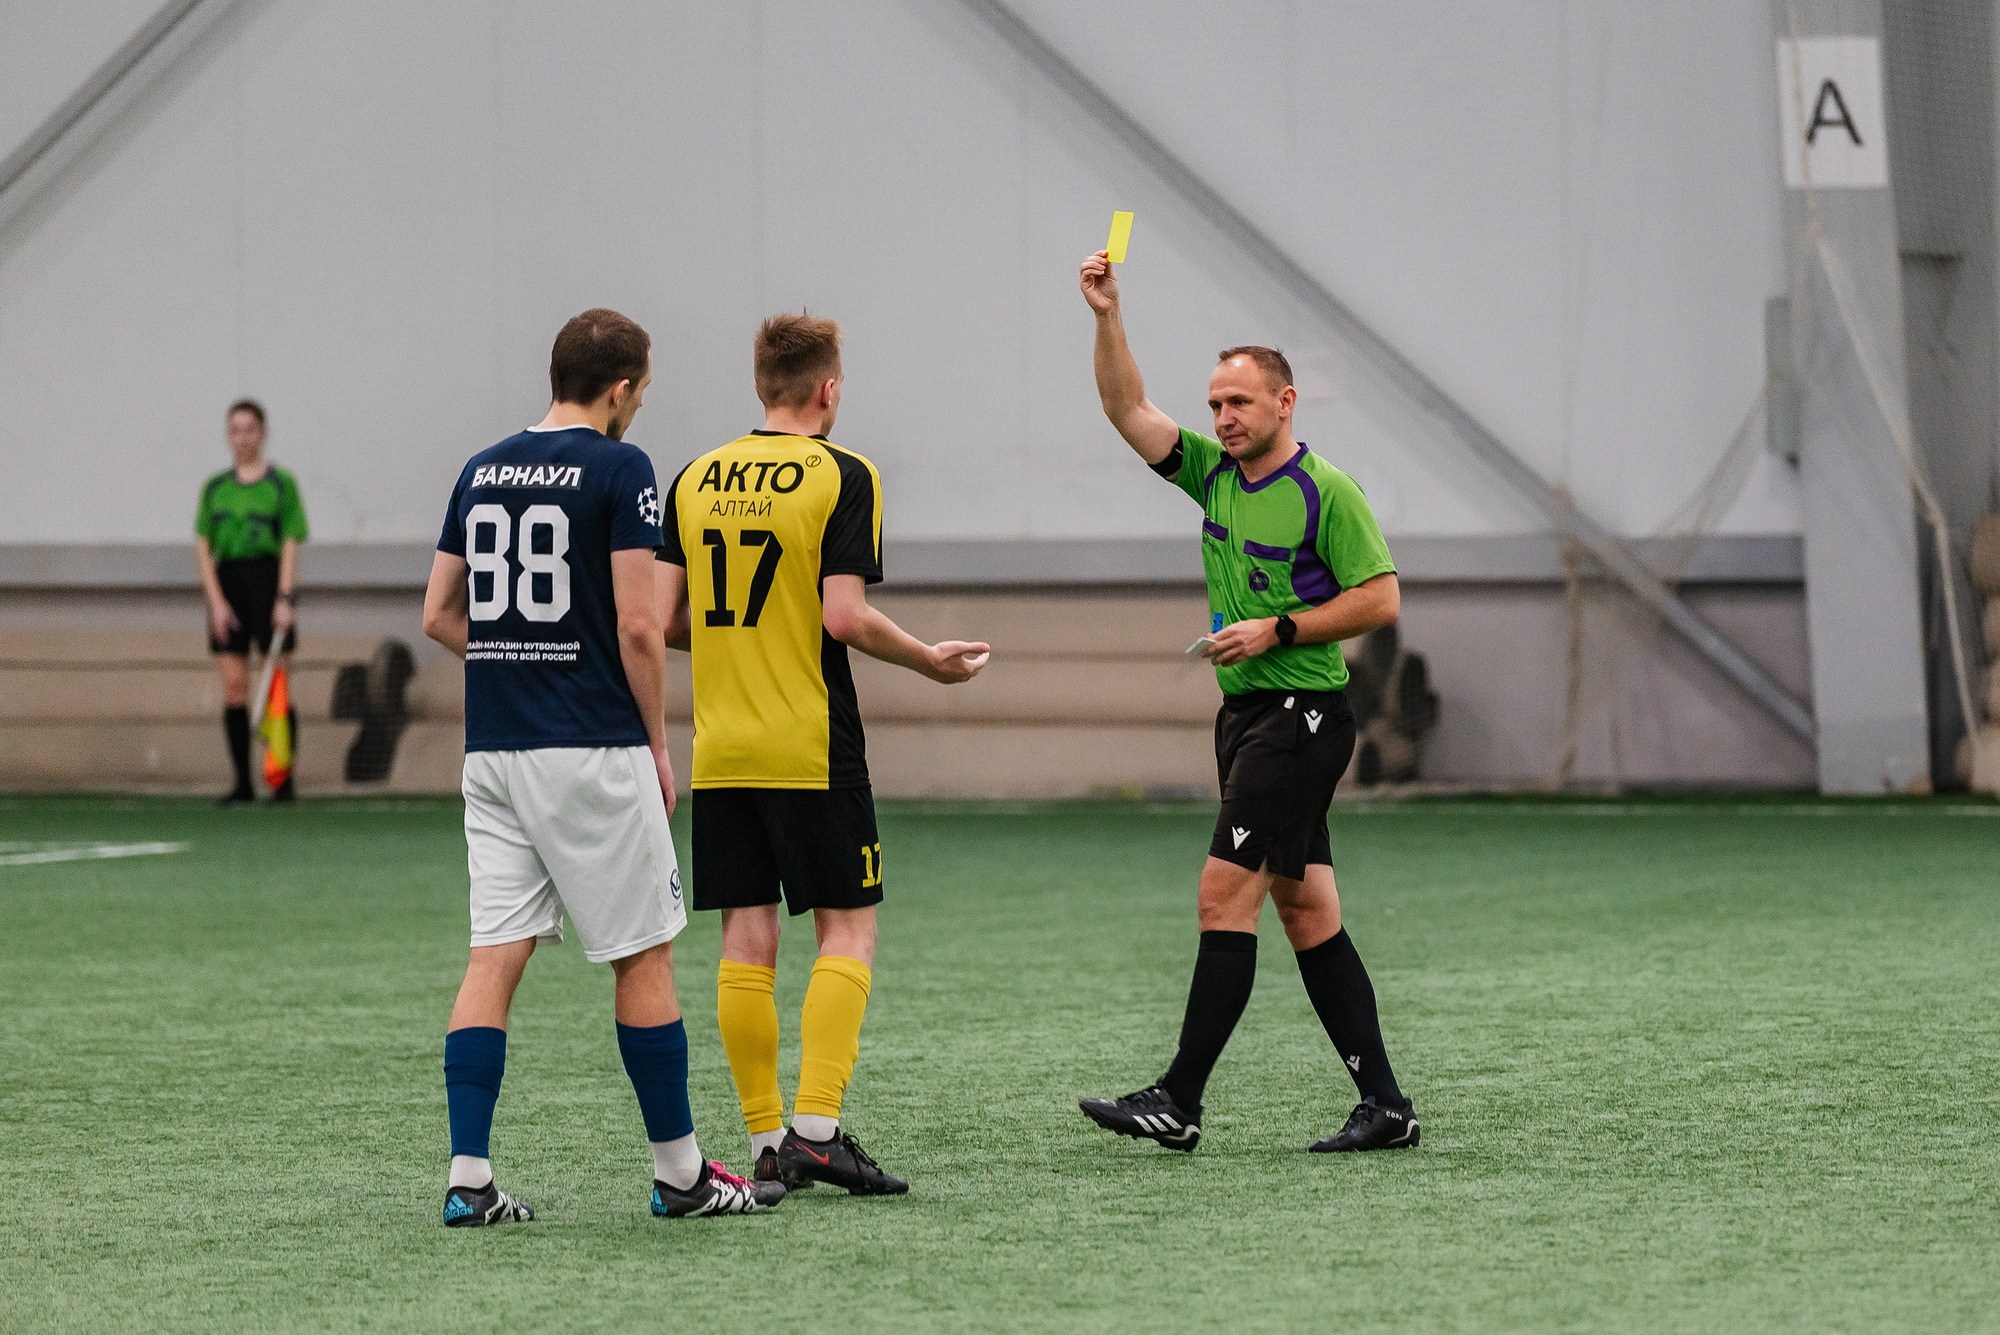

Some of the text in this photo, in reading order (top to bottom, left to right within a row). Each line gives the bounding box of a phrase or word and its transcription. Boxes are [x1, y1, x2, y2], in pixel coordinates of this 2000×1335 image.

[471, 465, 581, 488] БАРНАУЛ
[698, 460, 805, 494] АКТО
[709, 495, 772, 517] АЛТАЙ
[465, 504, 571, 622] 88
[702, 528, 784, 627] 17
[505, 652, 518, 661] ПО
[520, 651, 540, 661] ВСЕЙ
[542, 652, 577, 661] РОССИИ
[523, 641, 580, 651] ФУТБОЛЬНОЙ
[1385, 1110, 1402, 1121] COPA
